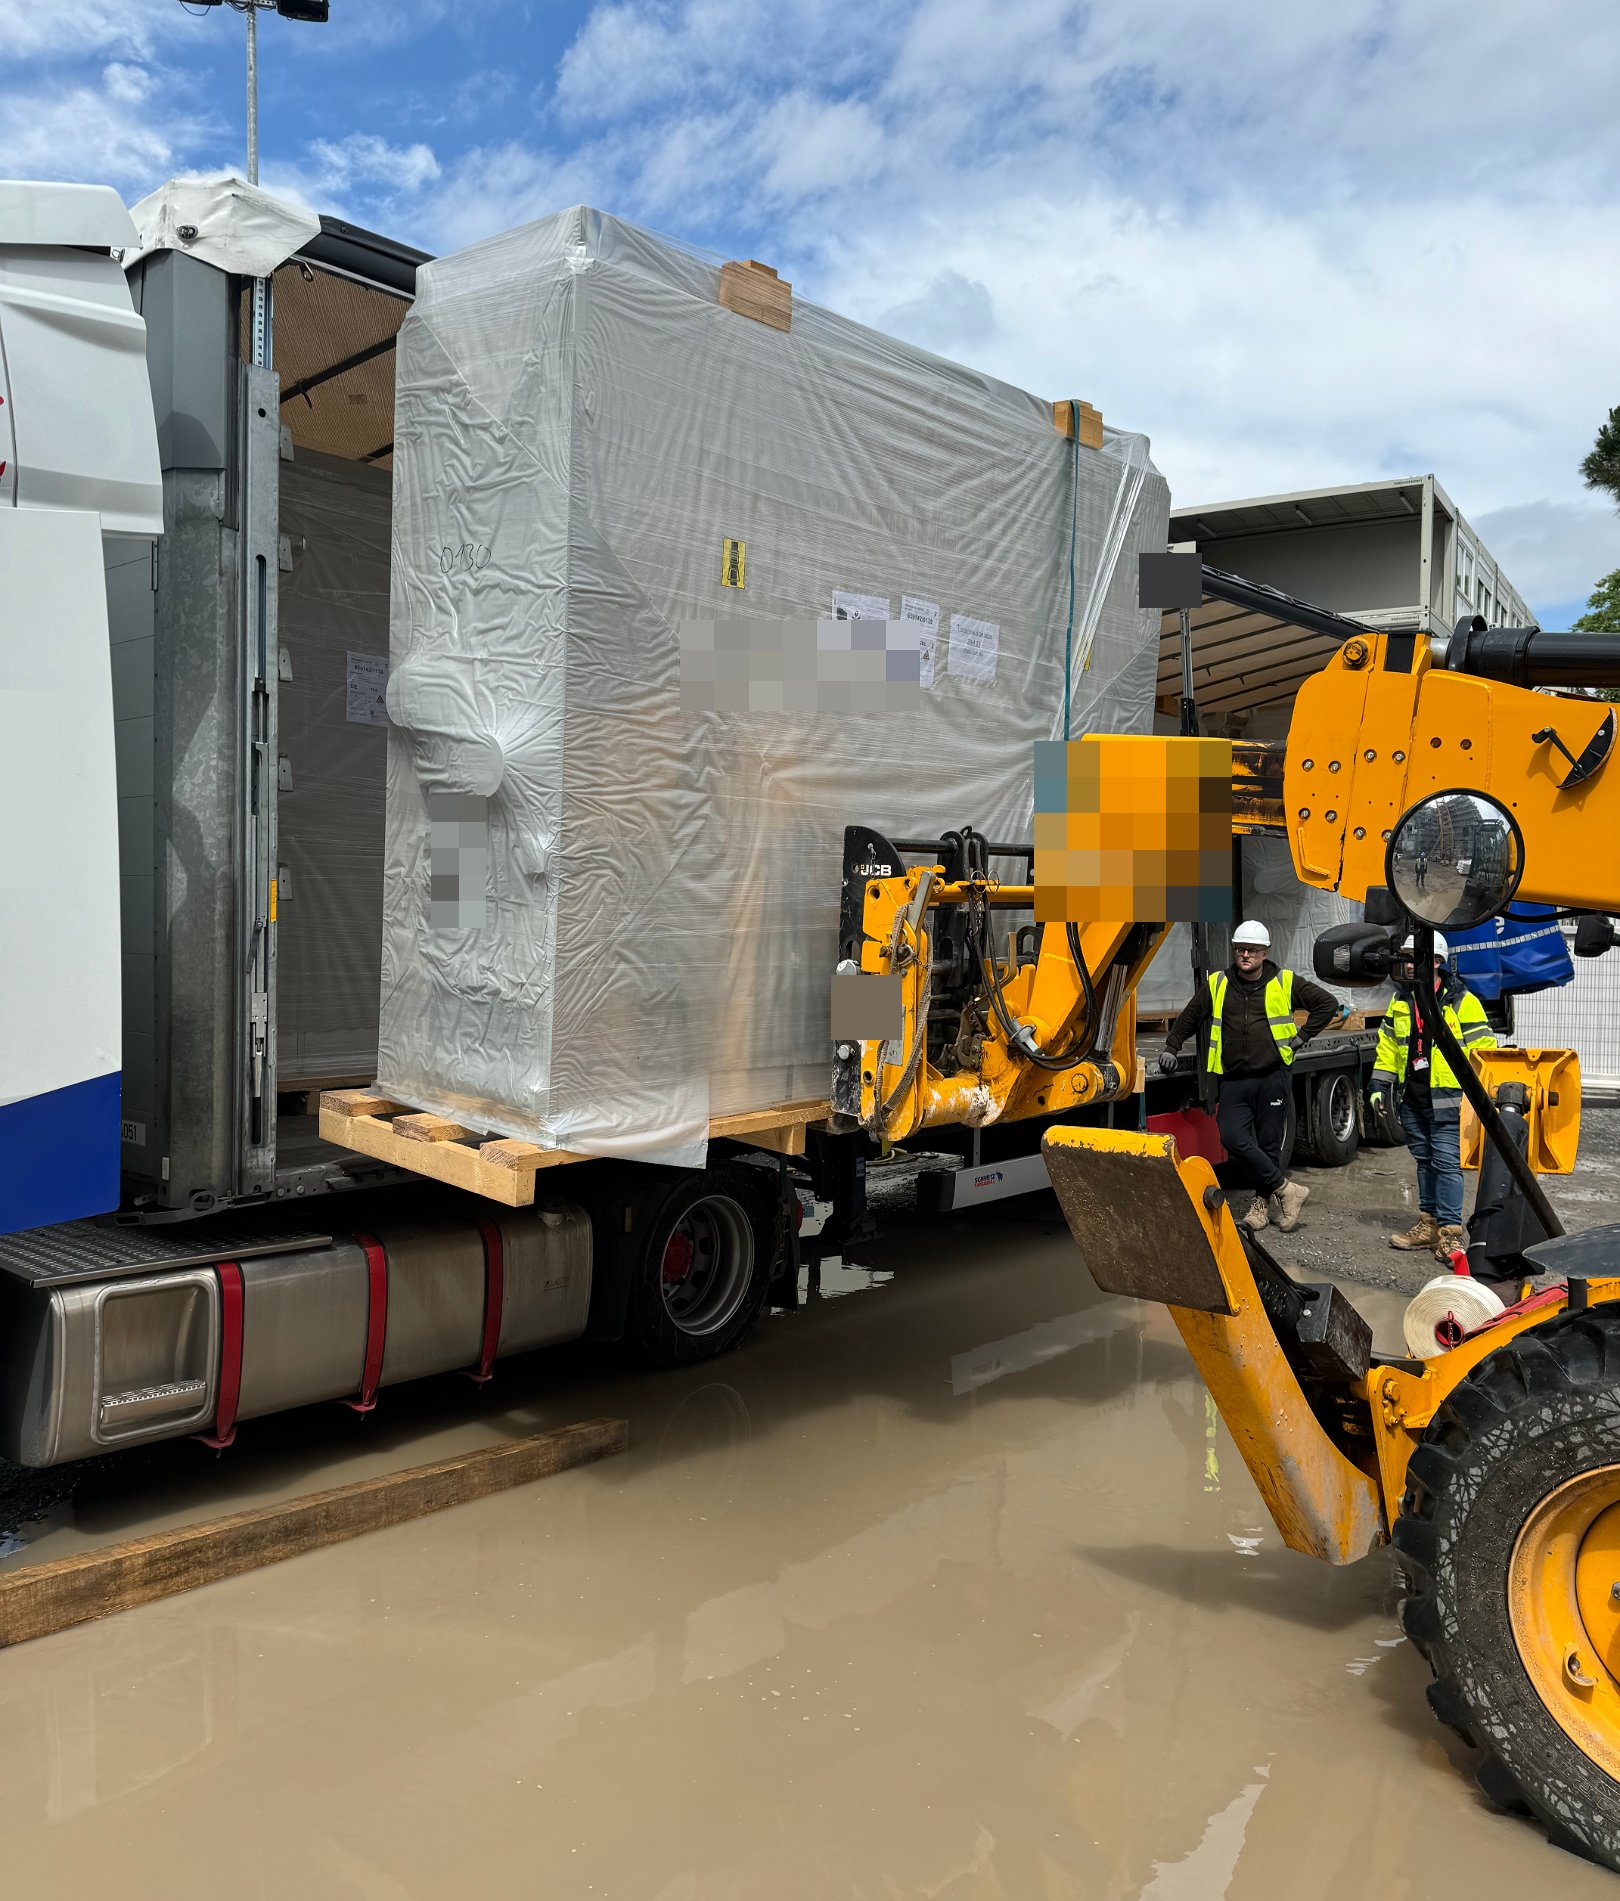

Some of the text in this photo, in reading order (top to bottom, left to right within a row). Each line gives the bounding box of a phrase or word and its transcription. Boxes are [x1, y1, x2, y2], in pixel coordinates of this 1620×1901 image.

[440, 543, 492, 573] 0130
[860, 864, 892, 876] JCB
[121, 1122, 137, 1141] 051
